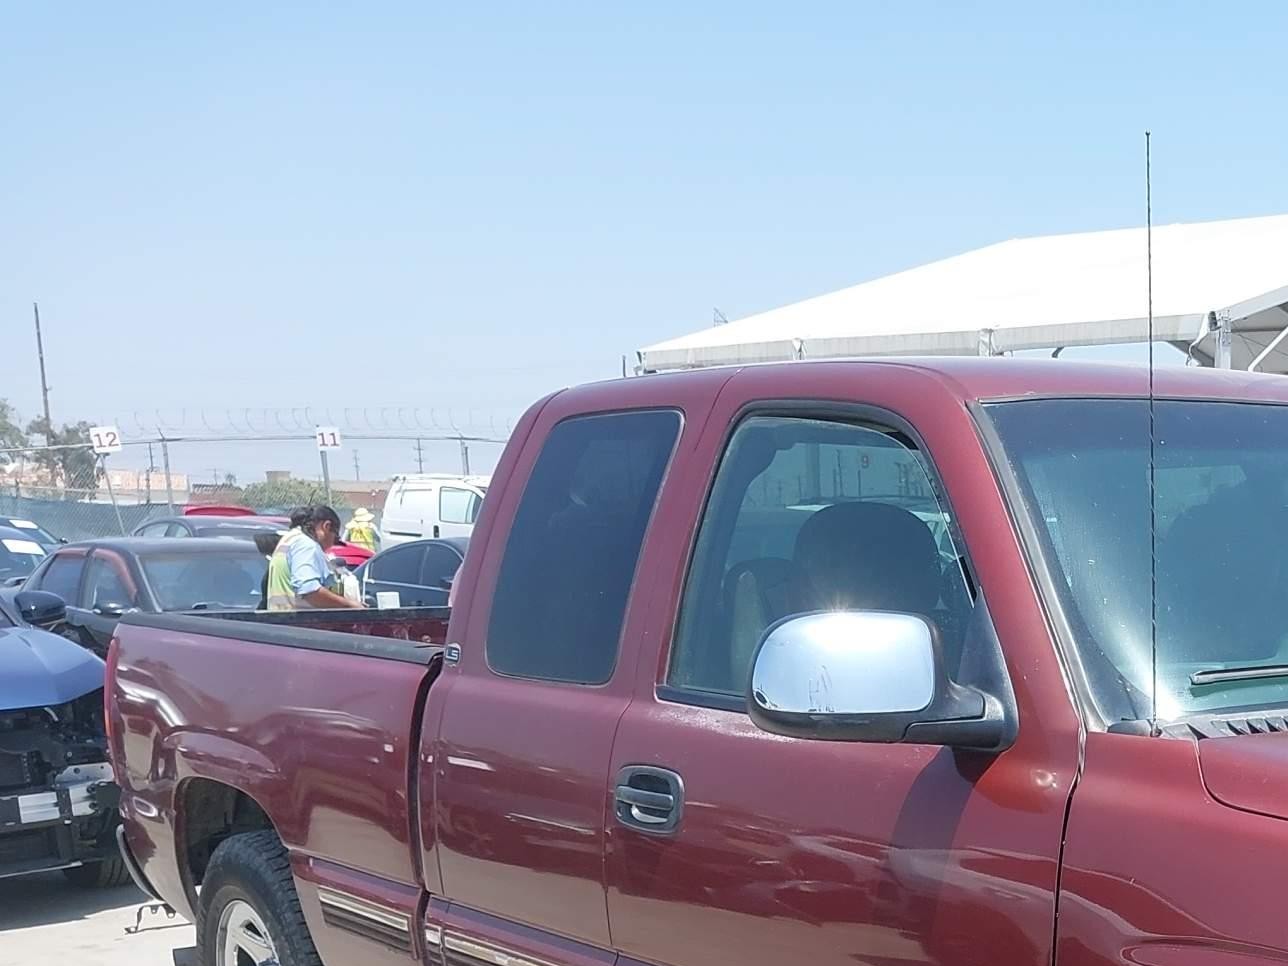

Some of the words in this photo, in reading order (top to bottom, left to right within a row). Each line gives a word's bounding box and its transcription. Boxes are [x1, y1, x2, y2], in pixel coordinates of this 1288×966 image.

[93, 431, 120, 449] 12
[317, 432, 341, 448] 11
[445, 647, 459, 661] LS
